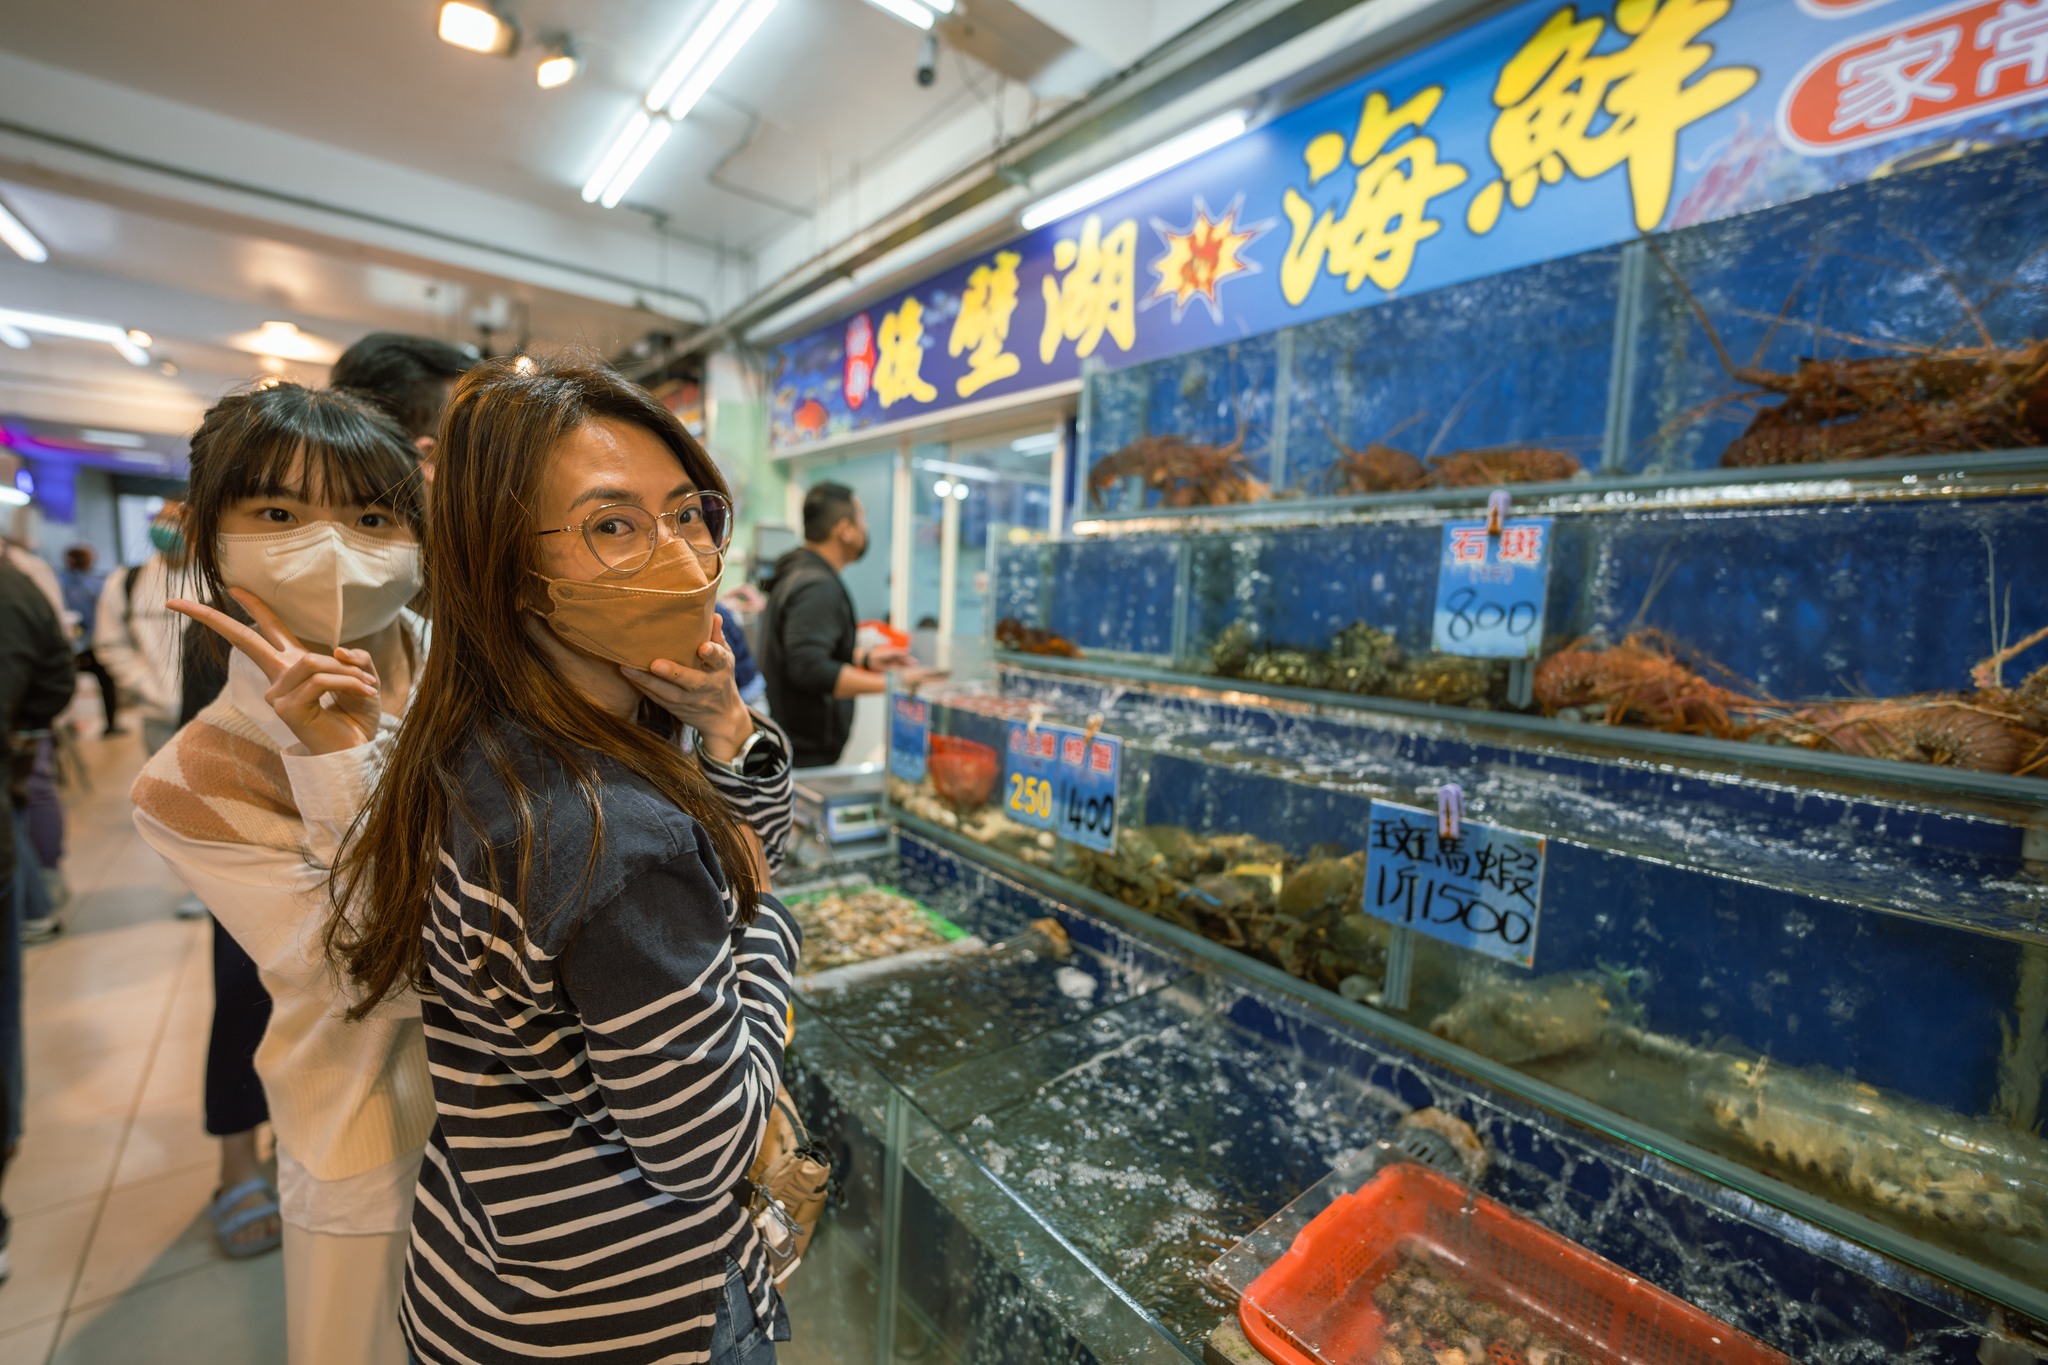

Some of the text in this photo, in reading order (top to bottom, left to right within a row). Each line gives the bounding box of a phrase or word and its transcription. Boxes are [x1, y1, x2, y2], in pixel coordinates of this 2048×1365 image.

[1280, 0, 1759, 306] 海鮮
[1452, 527, 1541, 562] 石斑
[1445, 587, 1537, 642] 800
[1010, 772, 1052, 818] 250
[1371, 818, 1538, 909] 斑馬蝦
